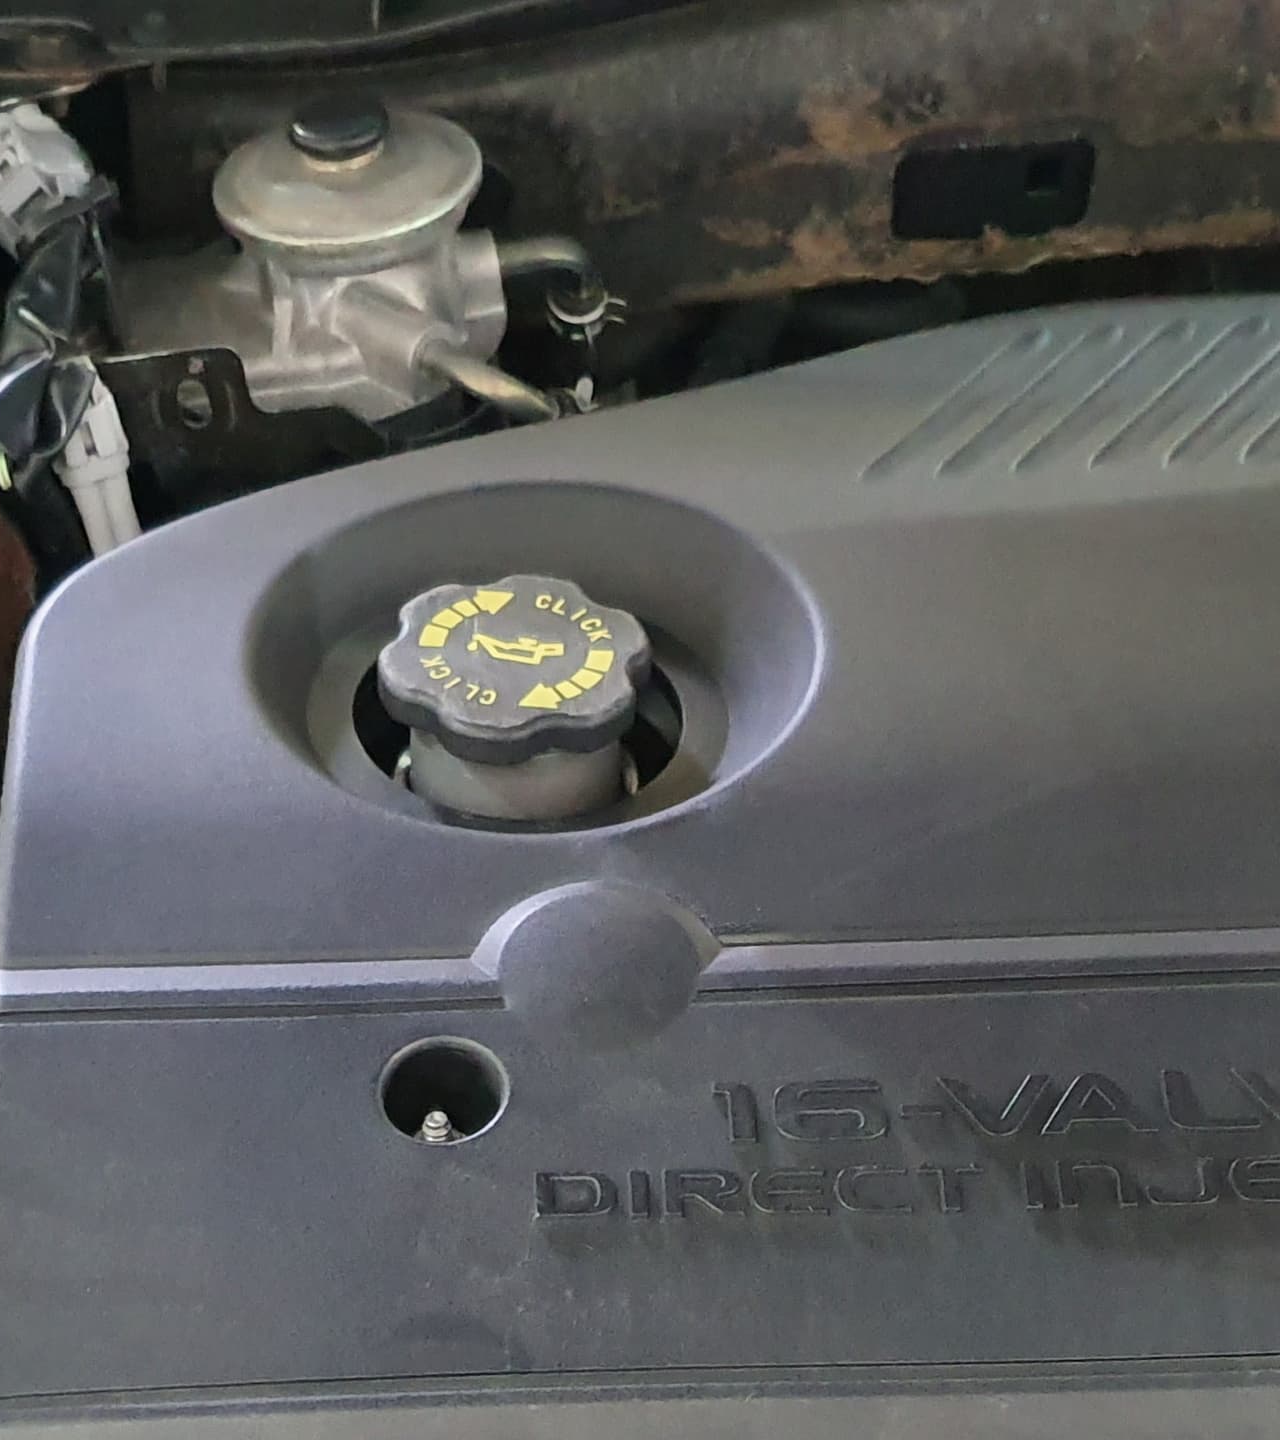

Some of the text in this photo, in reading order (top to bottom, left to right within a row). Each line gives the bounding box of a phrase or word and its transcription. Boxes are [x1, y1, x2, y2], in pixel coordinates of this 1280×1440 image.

[535, 594, 613, 643] CLICK
[420, 655, 498, 705] CLICK
[531, 1163, 984, 1219] DIRECT
